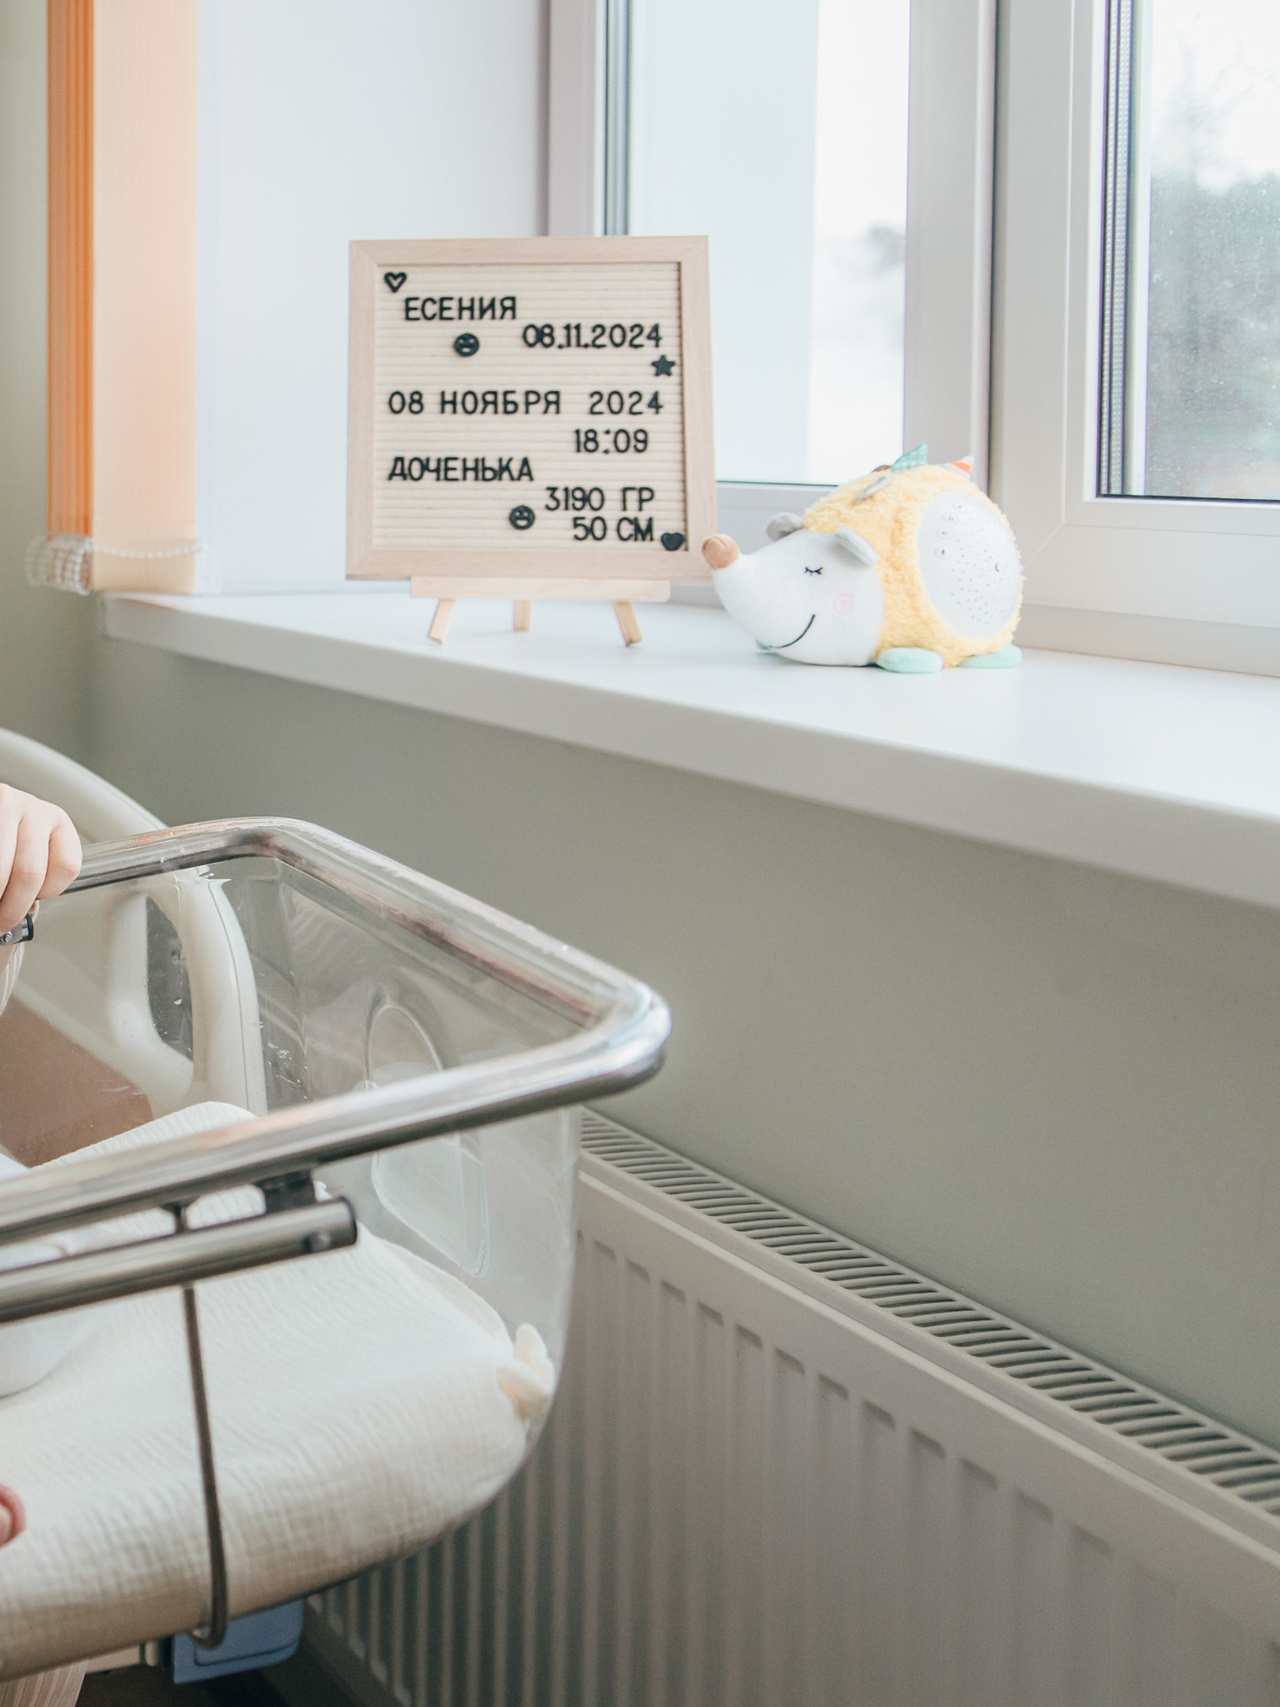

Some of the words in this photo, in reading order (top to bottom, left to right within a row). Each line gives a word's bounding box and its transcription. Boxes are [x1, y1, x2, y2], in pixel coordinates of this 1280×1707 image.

[403, 296, 517, 321] ЕСЕНИЯ
[521, 323, 663, 349] 08.11.2024
[387, 390, 425, 415] 08
[439, 389, 561, 416] НОЯБРЯ
[588, 390, 664, 416] 2024
[574, 428, 649, 454] 18:09
[387, 456, 535, 483] ДОЧЕНЬКА
[544, 486, 606, 512] 3190
[620, 486, 655, 512] ГР
[572, 515, 608, 542] 50
[615, 516, 655, 542] СМ
